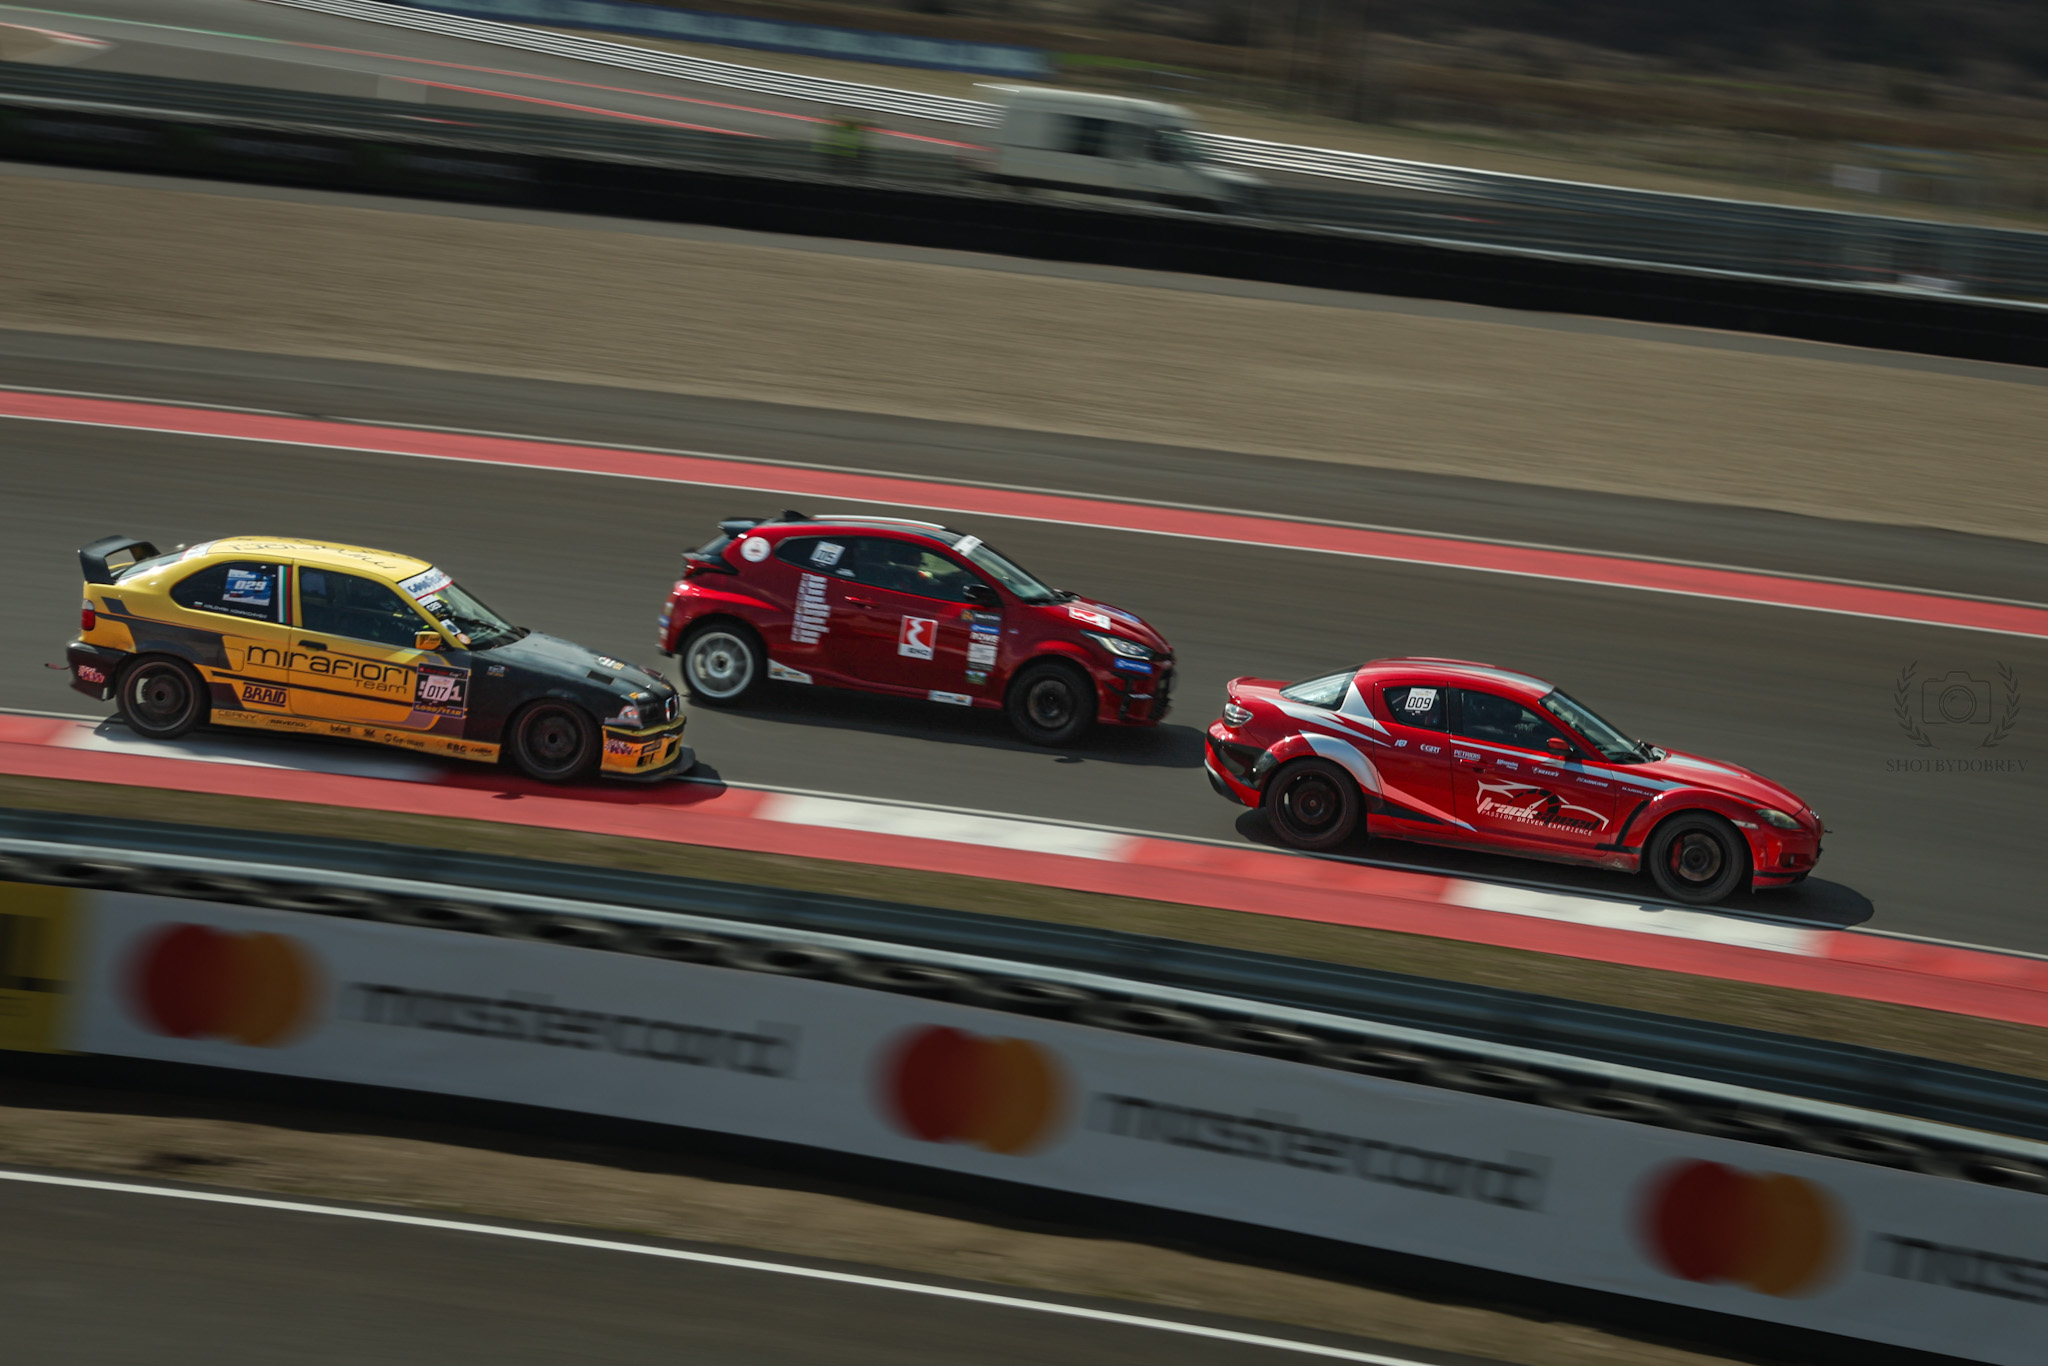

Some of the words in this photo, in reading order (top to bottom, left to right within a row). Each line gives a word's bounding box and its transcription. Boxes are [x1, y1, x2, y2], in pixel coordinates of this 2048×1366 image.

[234, 580, 267, 591] 029
[247, 645, 410, 685] mirafiori
[243, 685, 287, 704] BRAID
[427, 685, 448, 698] 017
[1408, 697, 1431, 708] 009
[447, 743, 467, 753] EBC
[1481, 810, 1513, 821] PASSION
[1517, 817, 1544, 827] DRIVEN
[1548, 823, 1593, 836] EXPERIENCE
